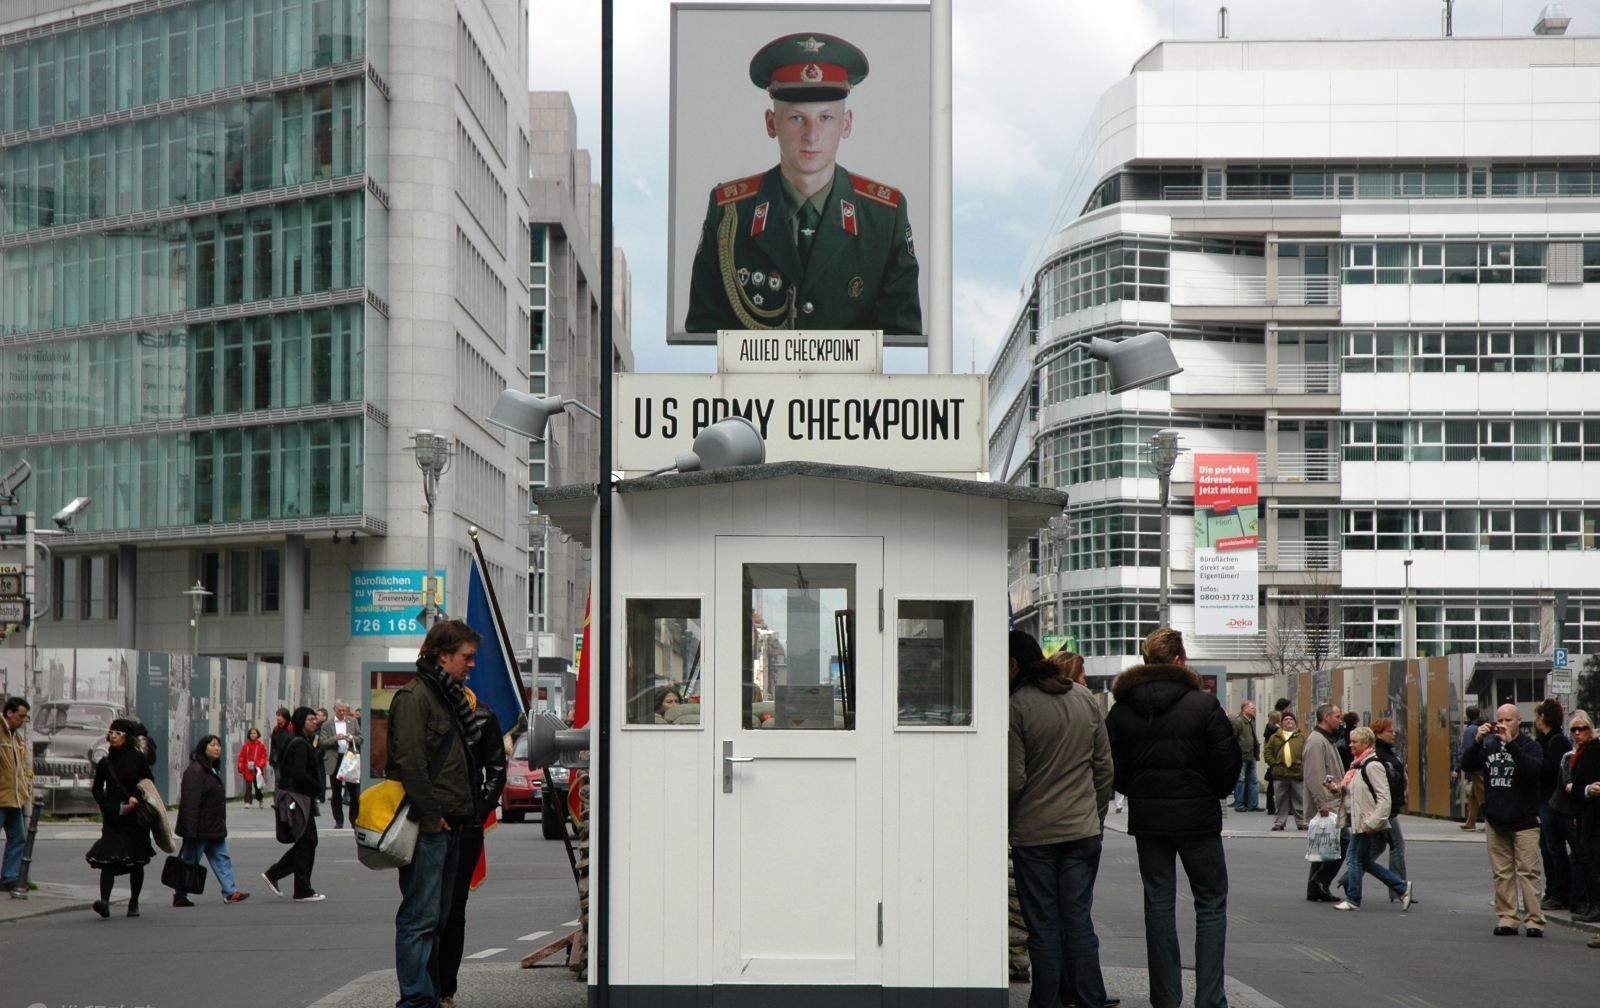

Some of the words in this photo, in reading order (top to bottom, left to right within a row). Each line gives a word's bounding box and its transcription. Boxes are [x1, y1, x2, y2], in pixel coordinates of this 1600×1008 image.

[740, 338, 779, 361] ALLIED
[785, 338, 860, 361] CHECKPOINT
[788, 398, 965, 440] CHECKPOINT
[1199, 465, 1213, 474] Die
[1215, 465, 1250, 476] perfekte
[1199, 475, 1235, 484] Adresse.
[1199, 486, 1219, 496] Jetzt
[1220, 486, 1253, 495] mieten!
[354, 575, 411, 586] Büroflächen
[377, 593, 420, 604] Zimmerstraße
[354, 619, 381, 632] 726
[388, 619, 417, 632] 165
[1228, 618, 1253, 626] Deka
